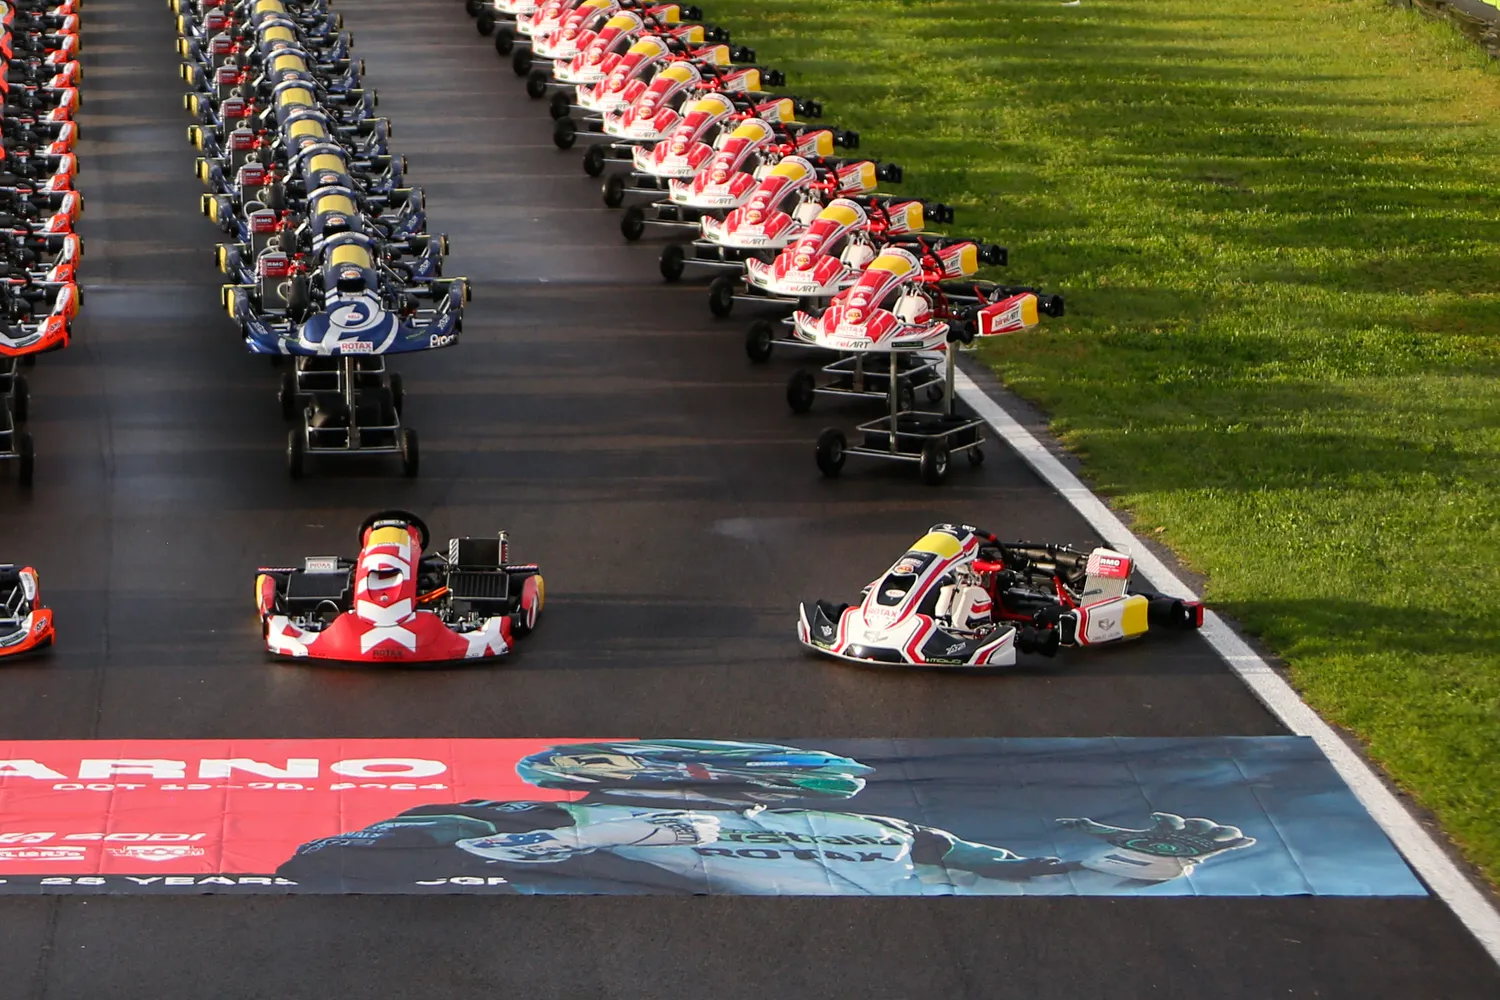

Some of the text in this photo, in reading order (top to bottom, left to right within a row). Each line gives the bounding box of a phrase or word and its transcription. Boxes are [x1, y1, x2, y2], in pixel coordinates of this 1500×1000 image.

[342, 342, 372, 350] ROTAX
[1100, 558, 1121, 567] RMC
[52, 783, 146, 791] OCT
[61, 832, 207, 842] SODI
[40, 876, 106, 886] 25
